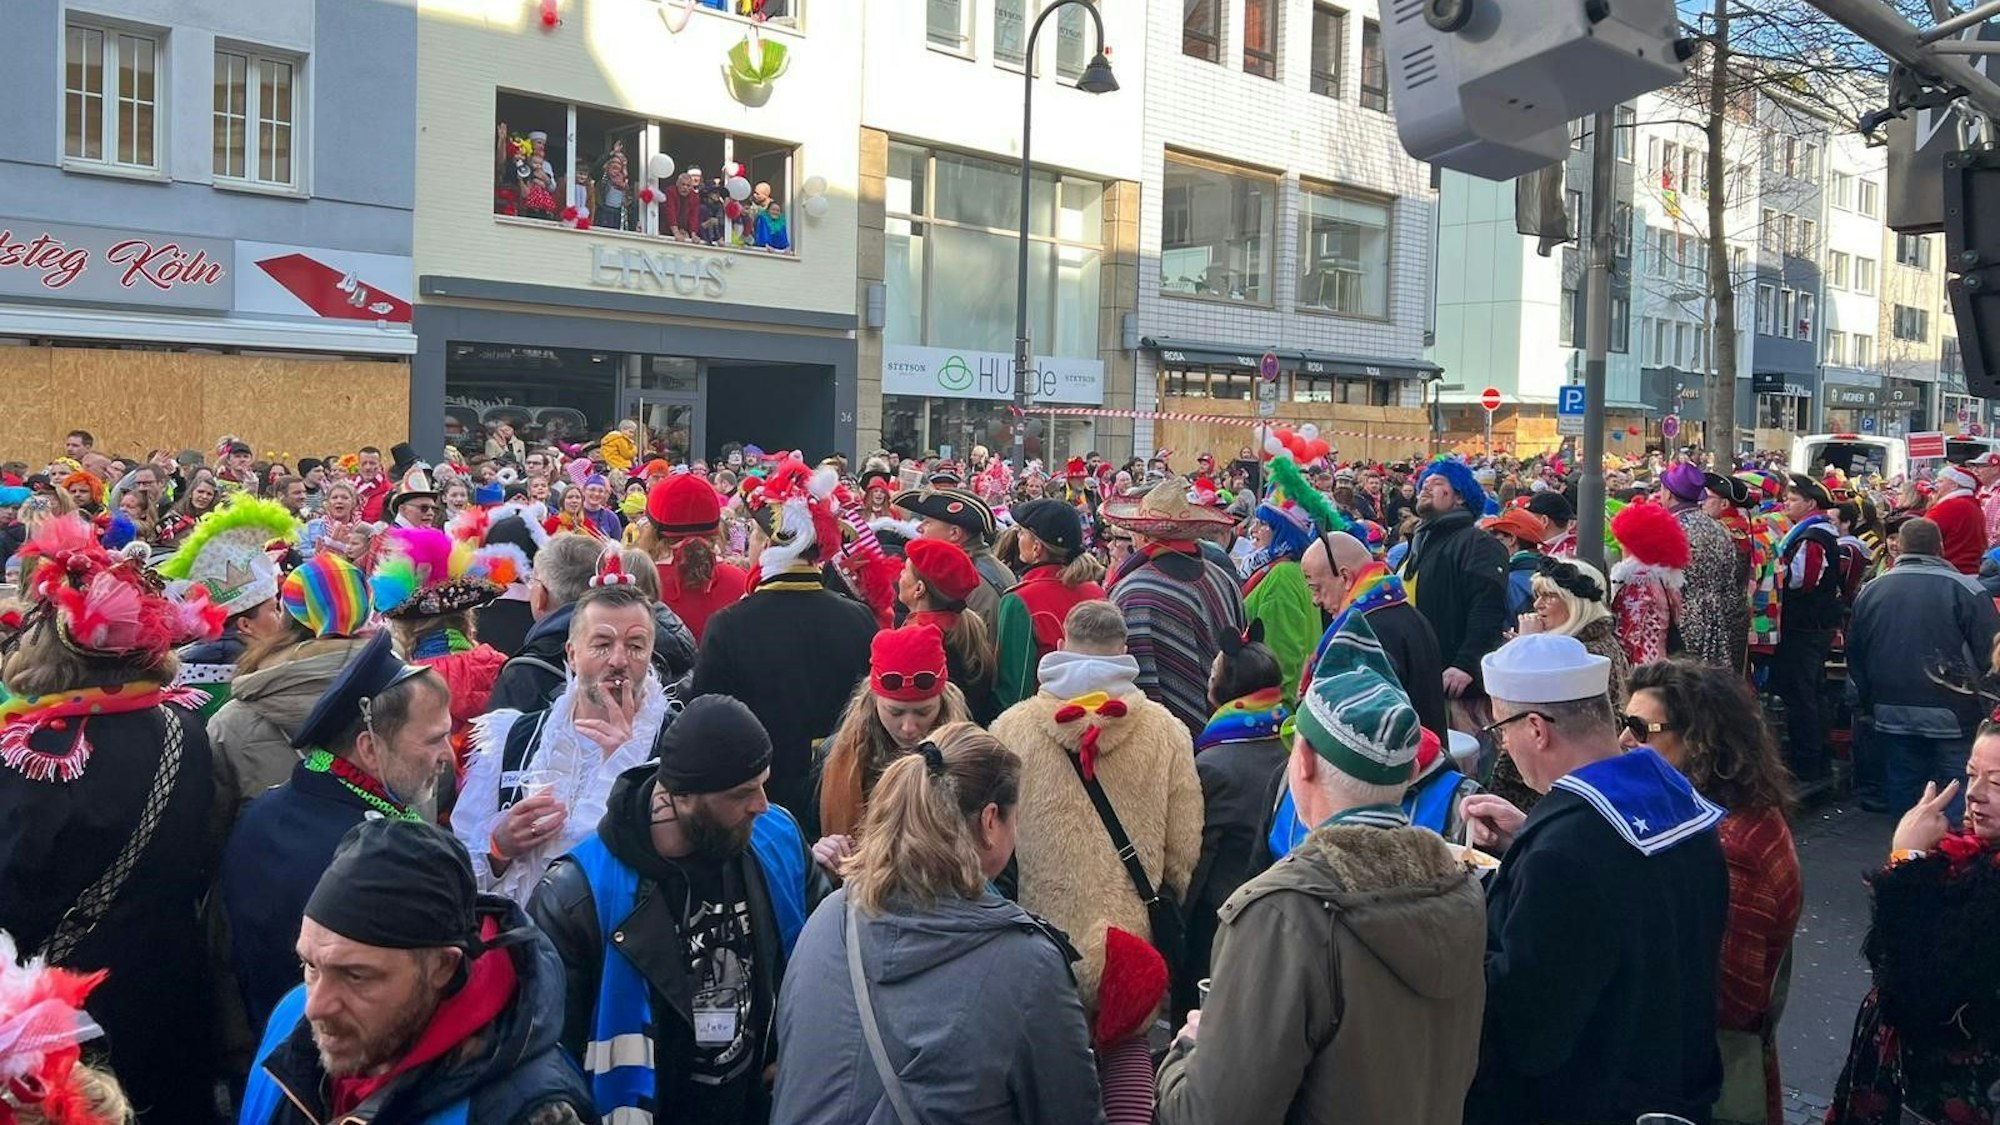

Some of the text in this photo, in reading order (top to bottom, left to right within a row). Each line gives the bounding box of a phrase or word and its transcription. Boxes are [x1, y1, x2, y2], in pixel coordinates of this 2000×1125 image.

[106, 238, 224, 290] Köln
[1164, 350, 1186, 361] ROSA
[888, 362, 926, 371] STETSON
[1237, 356, 1256, 367] ROSA
[1307, 362, 1324, 372] ROSA
[1366, 366, 1380, 376] ROSA
[1565, 390, 1583, 411] P
[841, 411, 852, 422] 36
